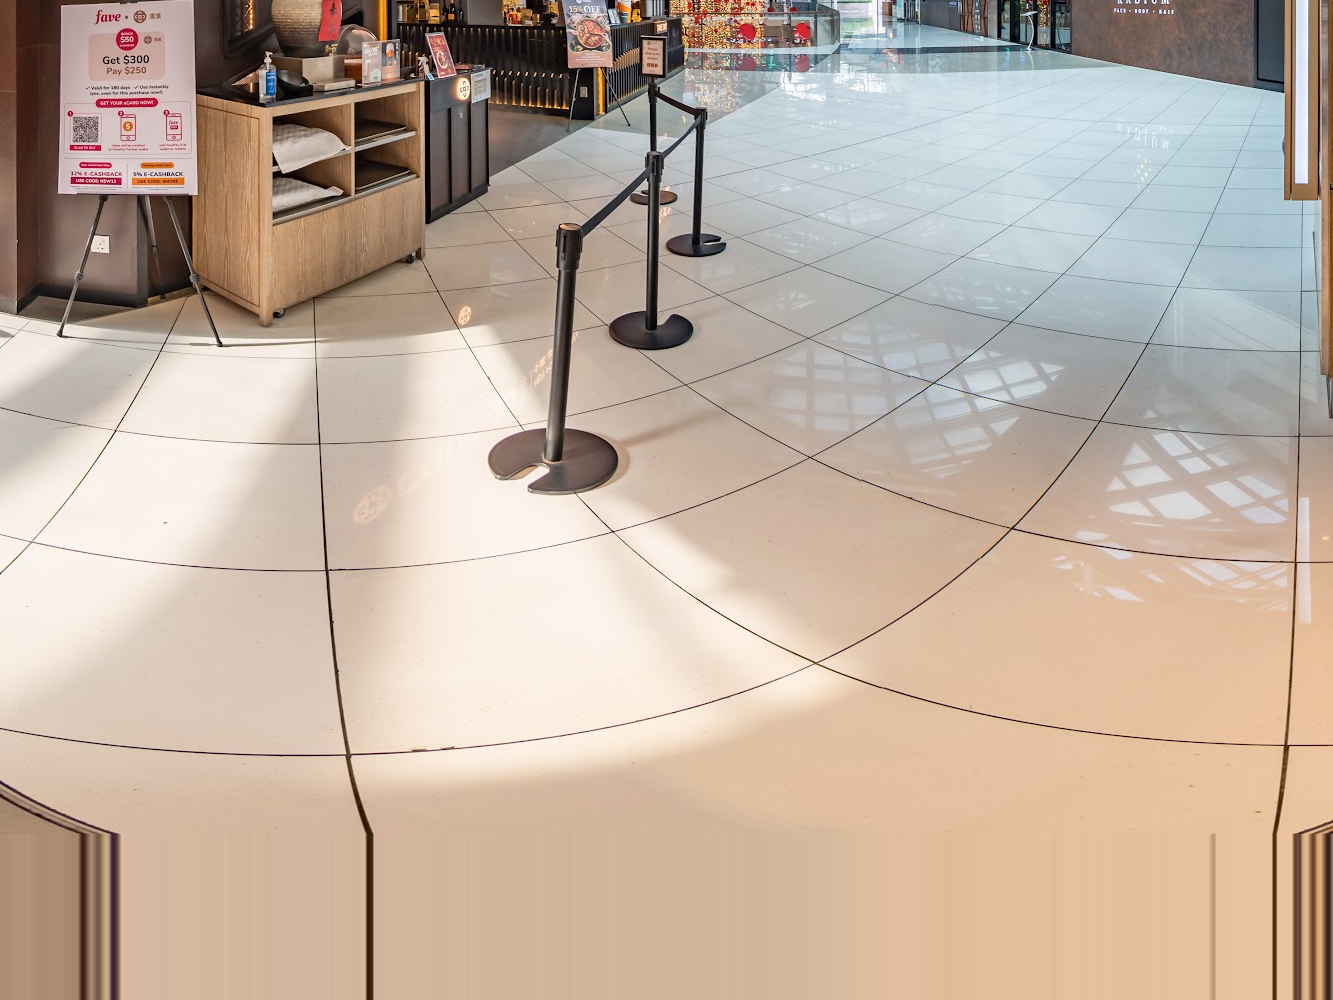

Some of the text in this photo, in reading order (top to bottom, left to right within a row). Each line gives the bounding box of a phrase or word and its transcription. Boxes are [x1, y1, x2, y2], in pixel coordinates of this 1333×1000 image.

[94, 10, 121, 24] fave
[102, 55, 150, 65] Get $300
[106, 66, 147, 76] Pay $250
